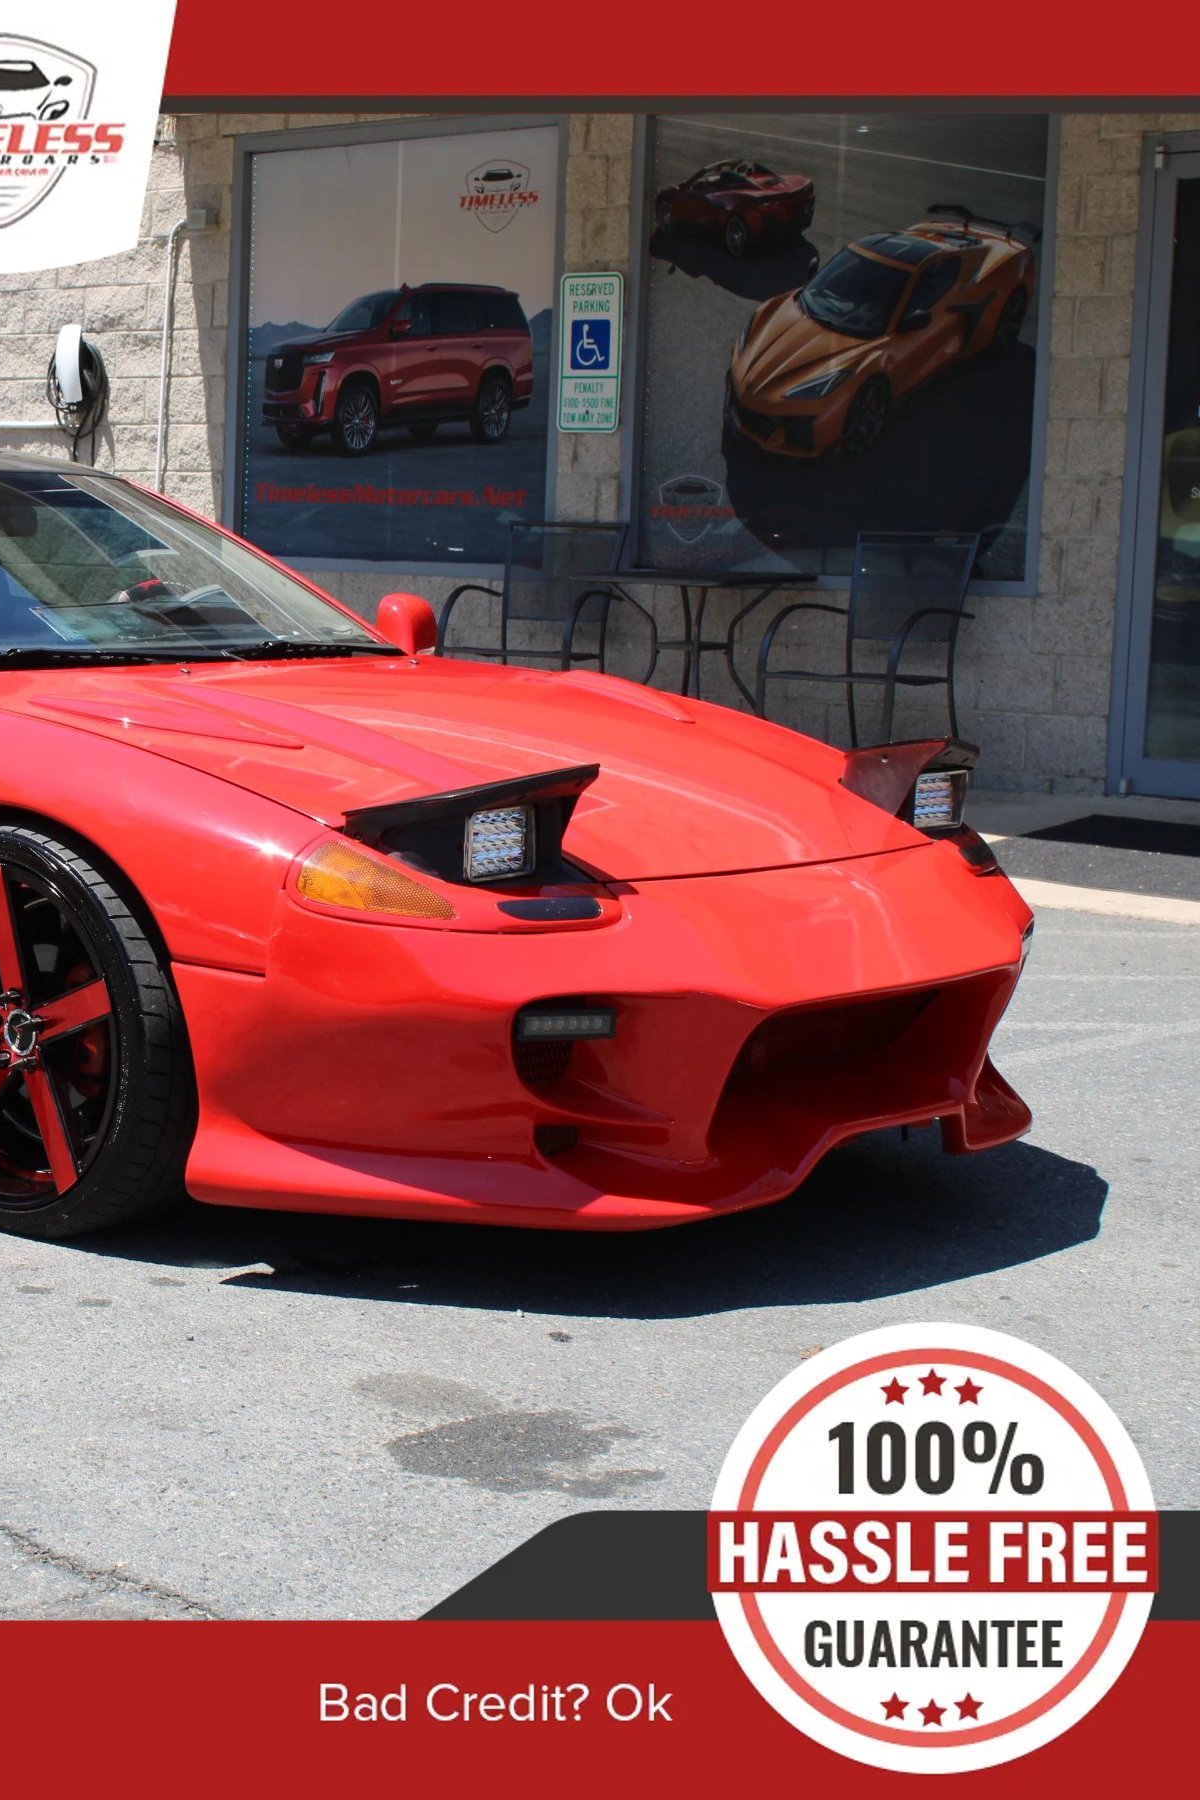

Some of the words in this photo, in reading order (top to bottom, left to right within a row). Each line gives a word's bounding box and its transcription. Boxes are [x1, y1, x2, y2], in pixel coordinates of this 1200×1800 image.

[569, 283, 615, 296] RESERVED
[573, 300, 611, 313] PARKING
[574, 382, 605, 393] PENALTY
[600, 397, 615, 408] FINE
[563, 412, 576, 423] TOW
[578, 412, 595, 423] AWAY
[597, 411, 613, 423] ZONE
[256, 482, 527, 508] TimelessMotorcars.Net
